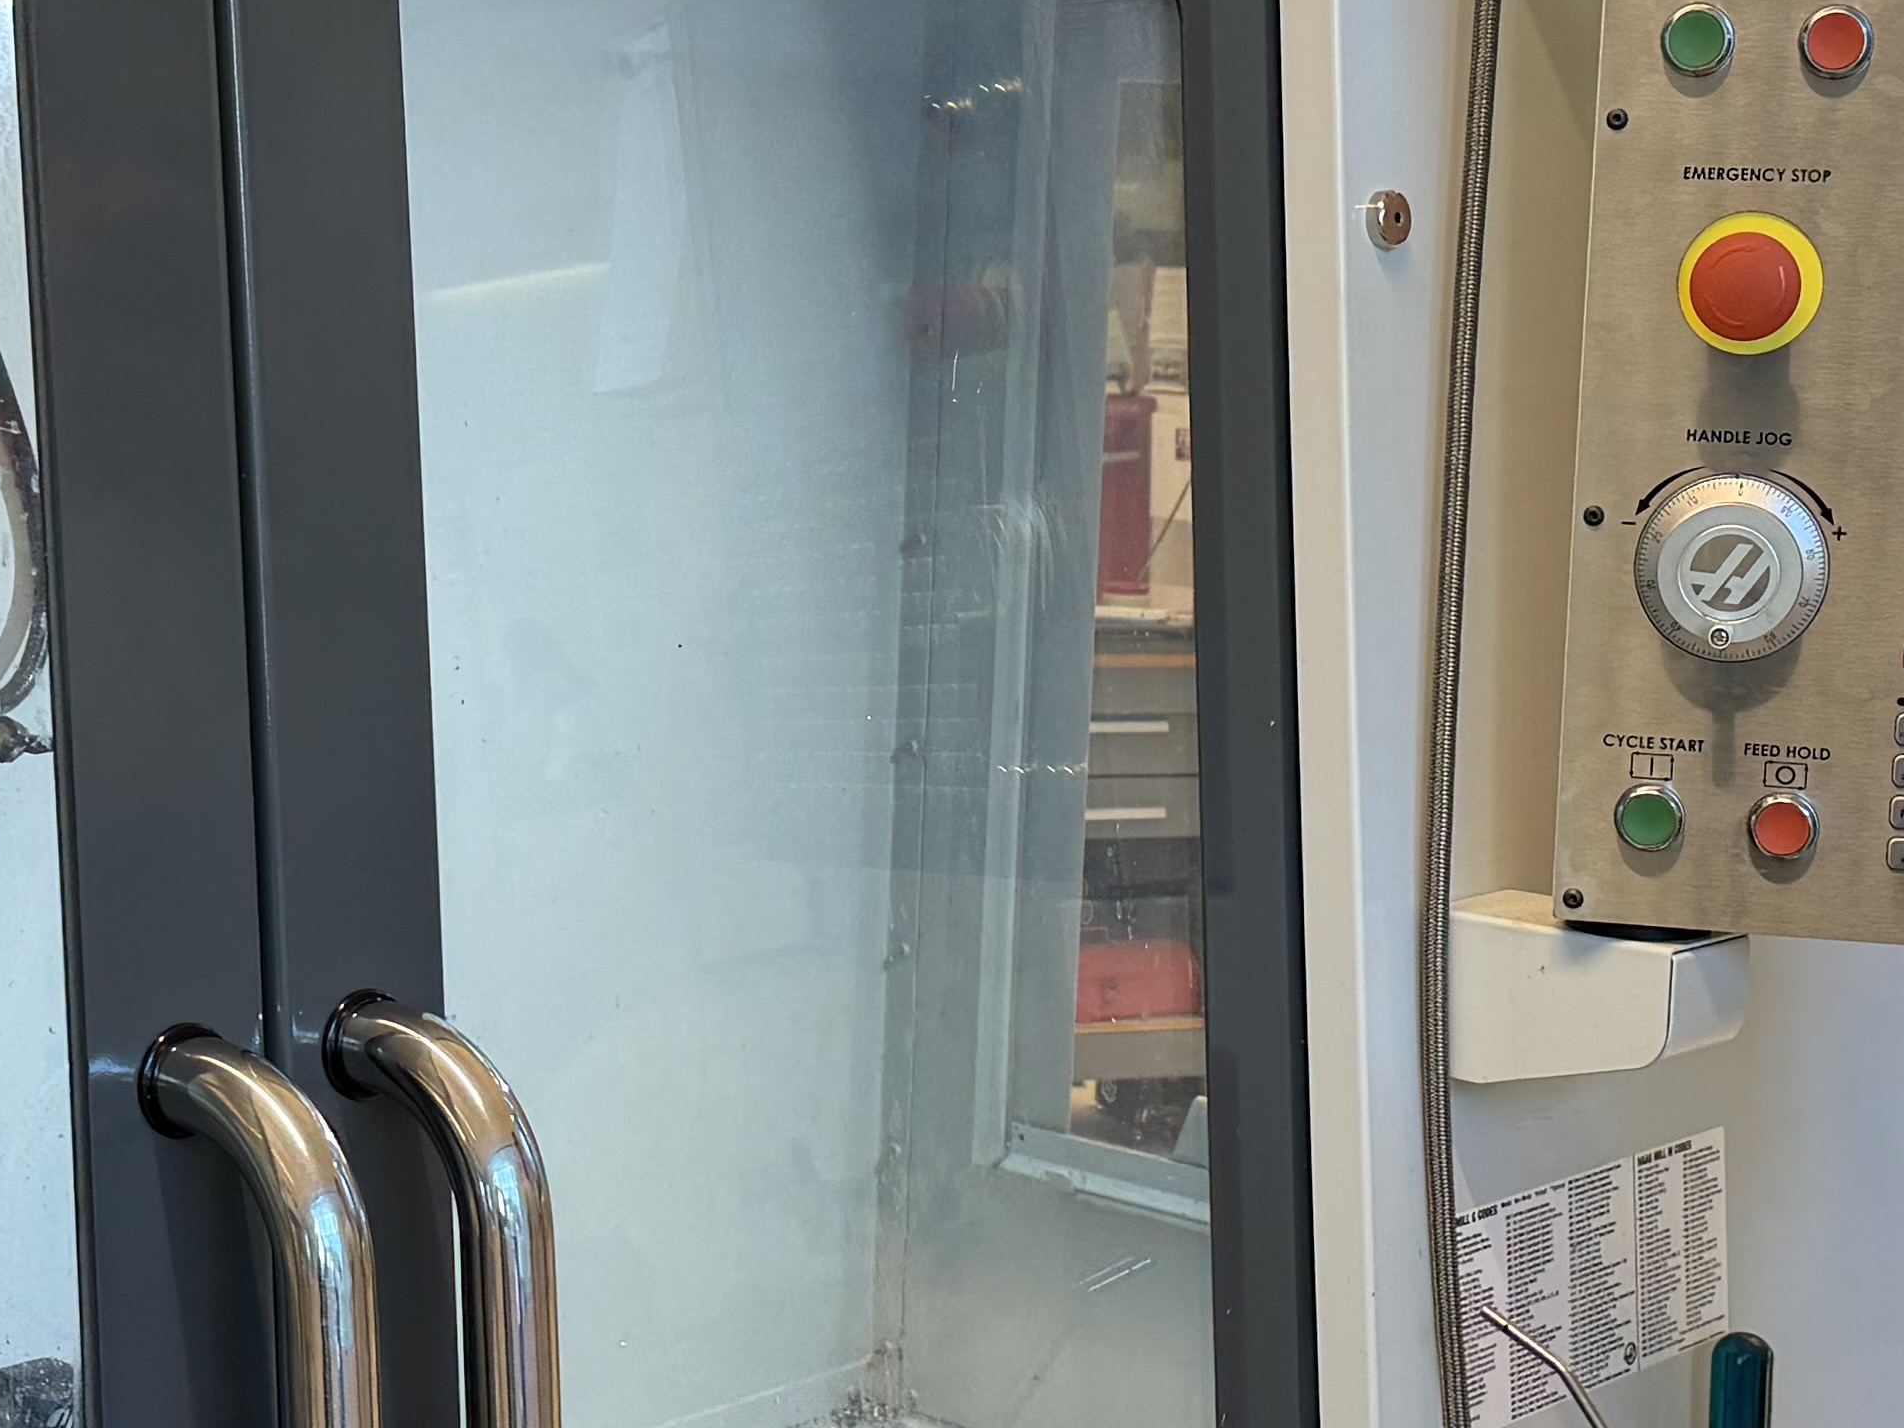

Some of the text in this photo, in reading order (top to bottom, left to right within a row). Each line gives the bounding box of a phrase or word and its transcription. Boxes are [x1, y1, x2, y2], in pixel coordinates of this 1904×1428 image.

[1683, 166, 1832, 183] EMERGENCY STOP
[1687, 429, 1792, 446] HANDLE JOG
[1602, 733, 1705, 753] CYCLE START
[1744, 743, 1831, 761] FEED HOLD
